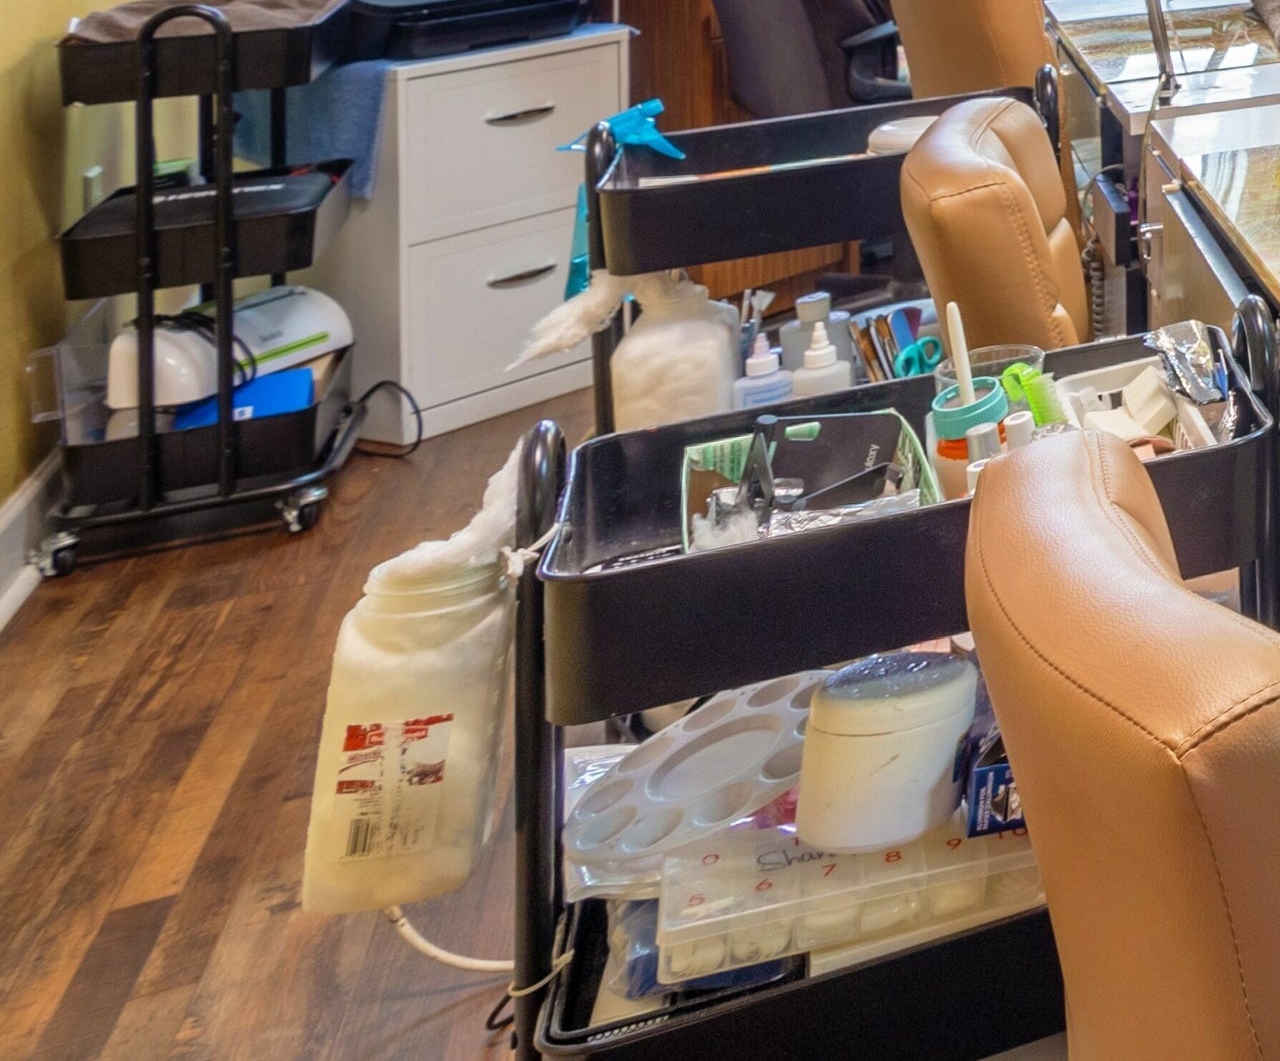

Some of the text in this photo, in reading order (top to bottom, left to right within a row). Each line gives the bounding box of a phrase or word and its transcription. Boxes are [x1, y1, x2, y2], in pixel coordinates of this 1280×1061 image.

[688, 837, 962, 907] 5 6 7 8 9
